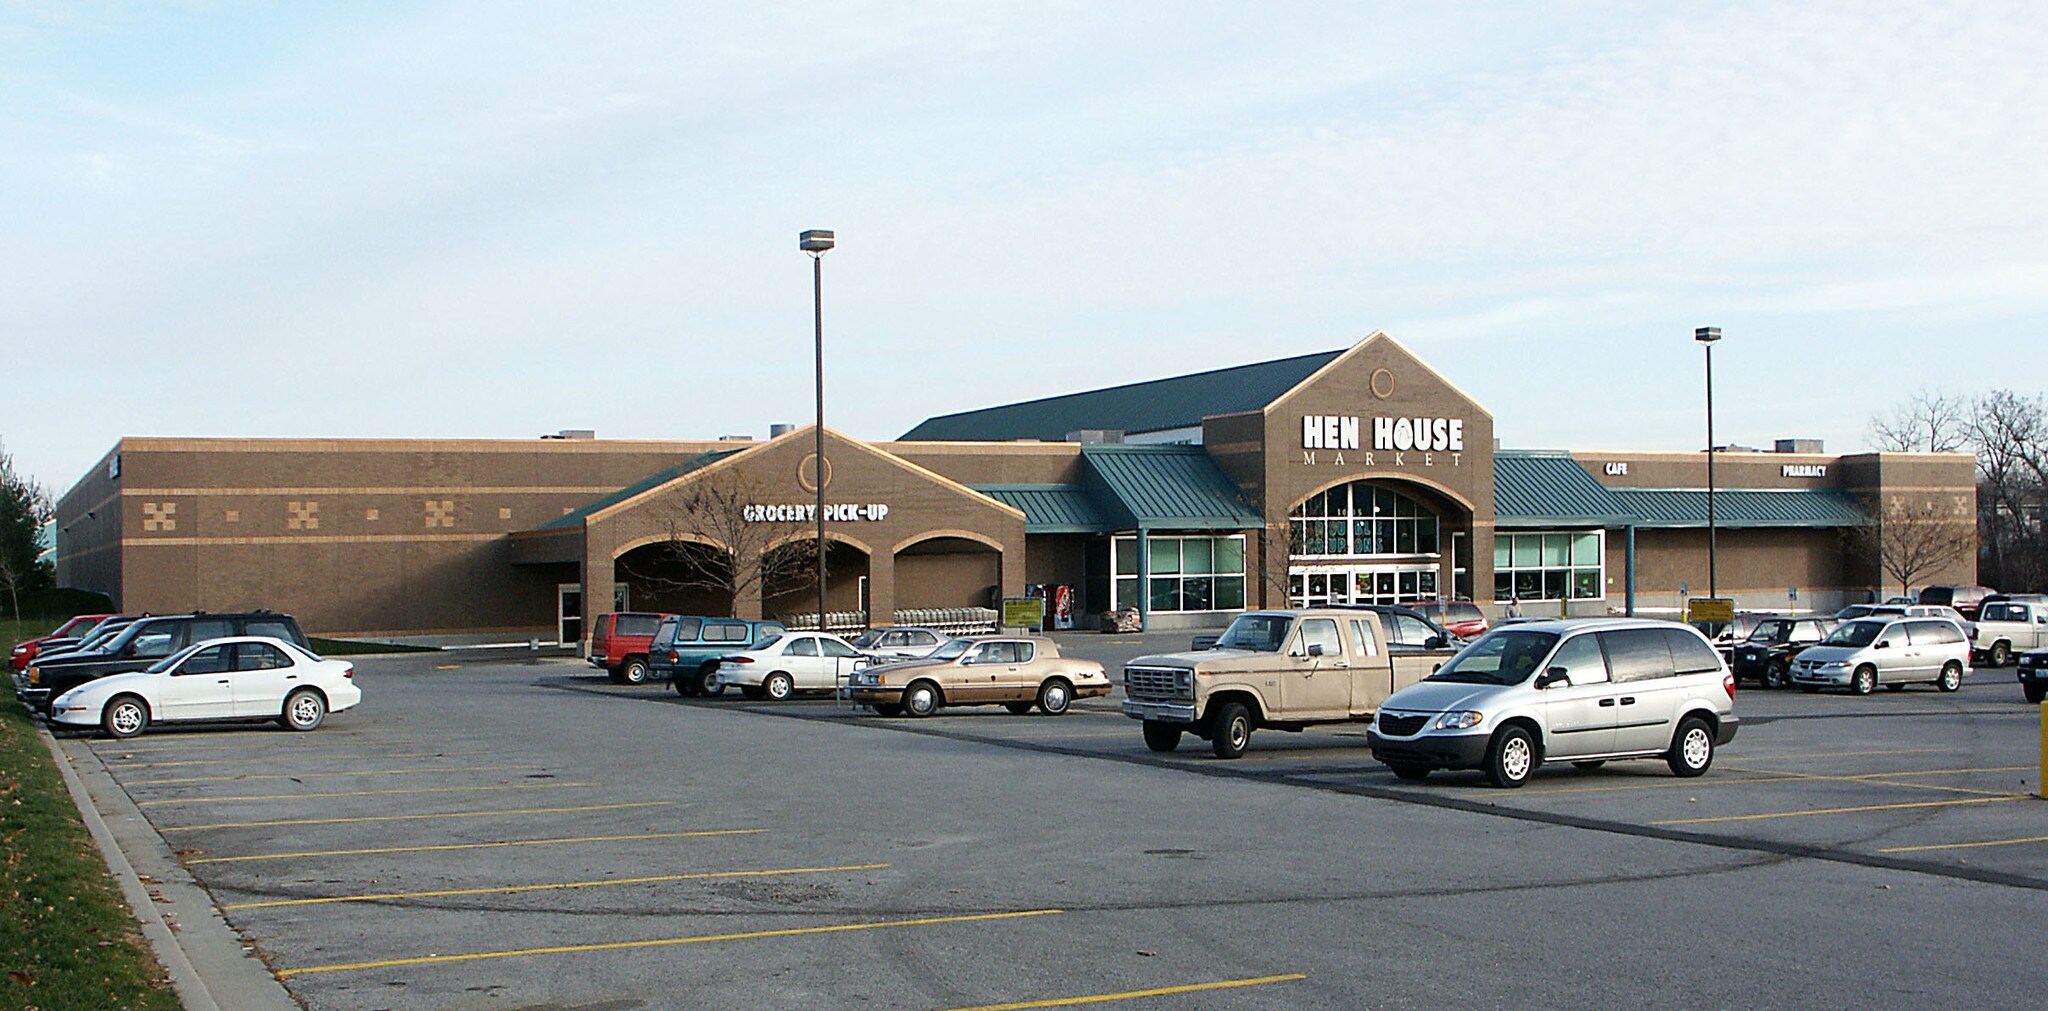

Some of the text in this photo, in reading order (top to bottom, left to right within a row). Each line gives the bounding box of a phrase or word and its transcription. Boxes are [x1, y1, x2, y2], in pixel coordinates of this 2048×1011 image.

[1303, 415, 1464, 451] HEN HOUSE
[1303, 451, 1461, 466] MARKET
[1605, 462, 1628, 475] CAFE
[1782, 464, 1827, 477] PHARMACY
[743, 503, 889, 522] GROCERY PICK-UP
[1307, 538, 1384, 553] COUPONS
